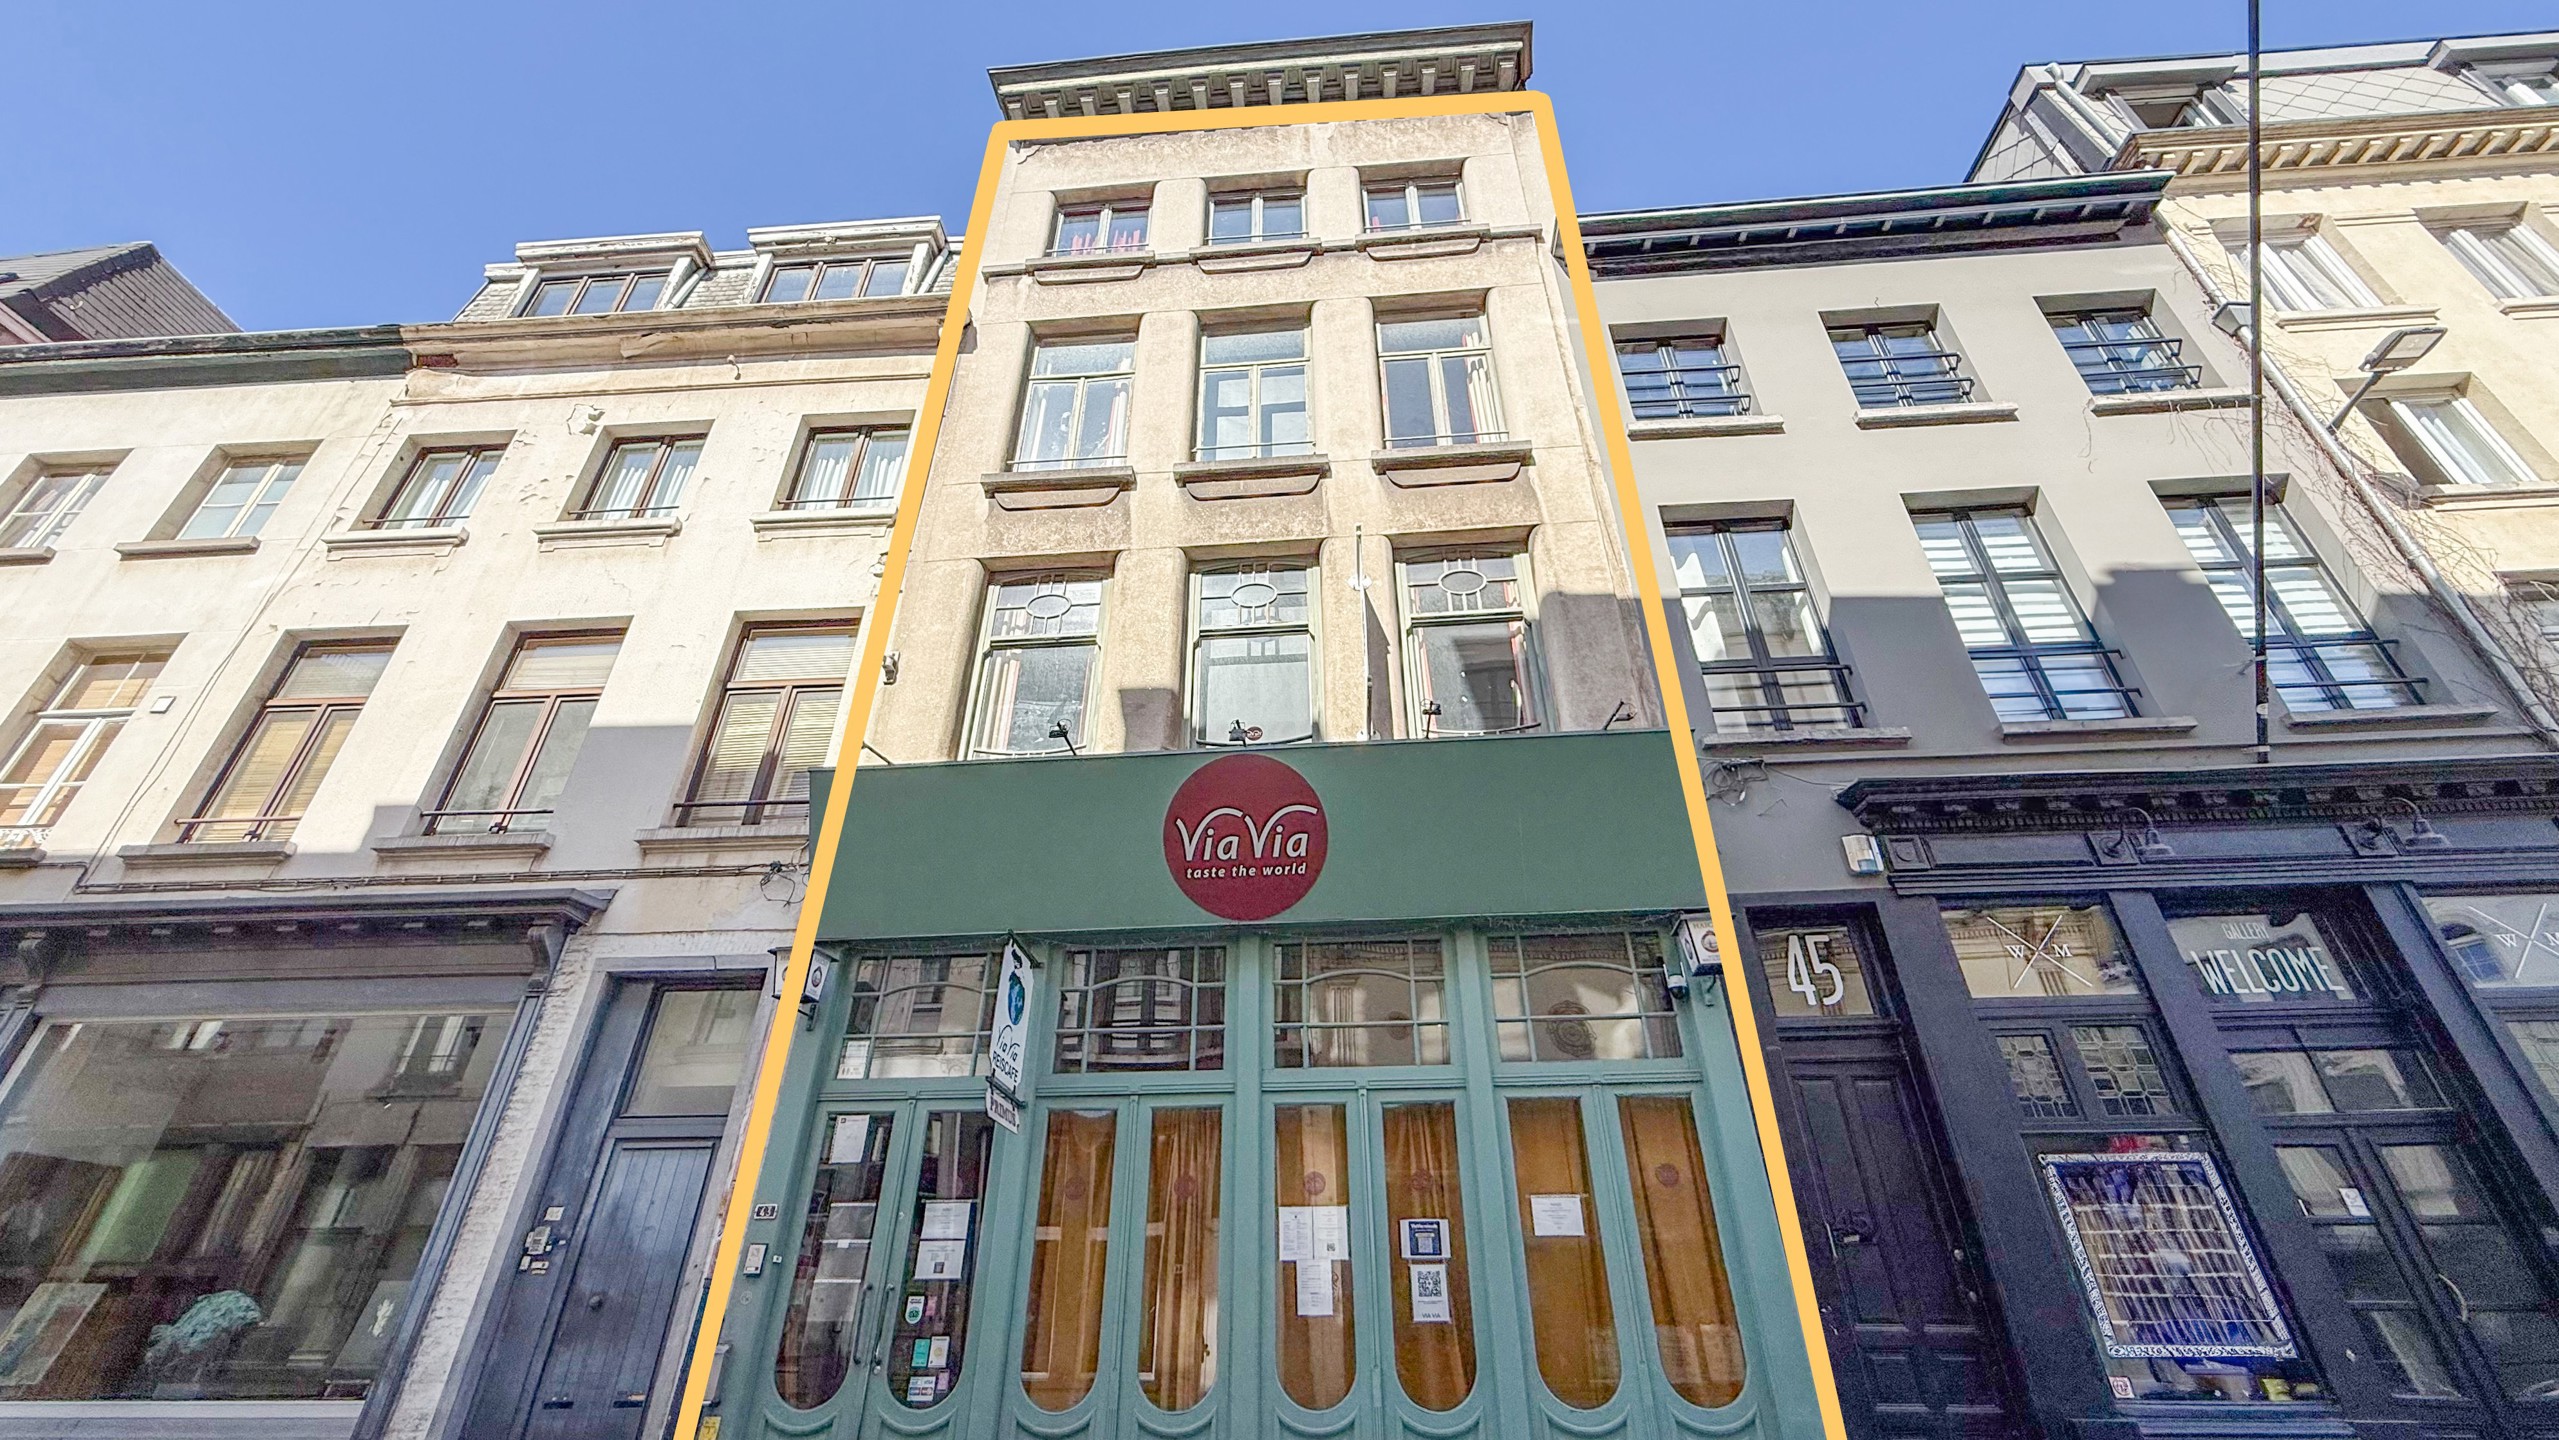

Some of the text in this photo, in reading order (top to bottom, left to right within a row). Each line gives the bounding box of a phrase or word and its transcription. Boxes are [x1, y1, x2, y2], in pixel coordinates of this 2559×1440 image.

[1186, 862, 1307, 879] taste the world
[2221, 922, 2269, 940] GALLERY
[2493, 933, 2517, 948] W
[2004, 943, 2073, 959] W M
[1786, 934, 1844, 1006] 45
[2189, 947, 2345, 994] WELCOME
